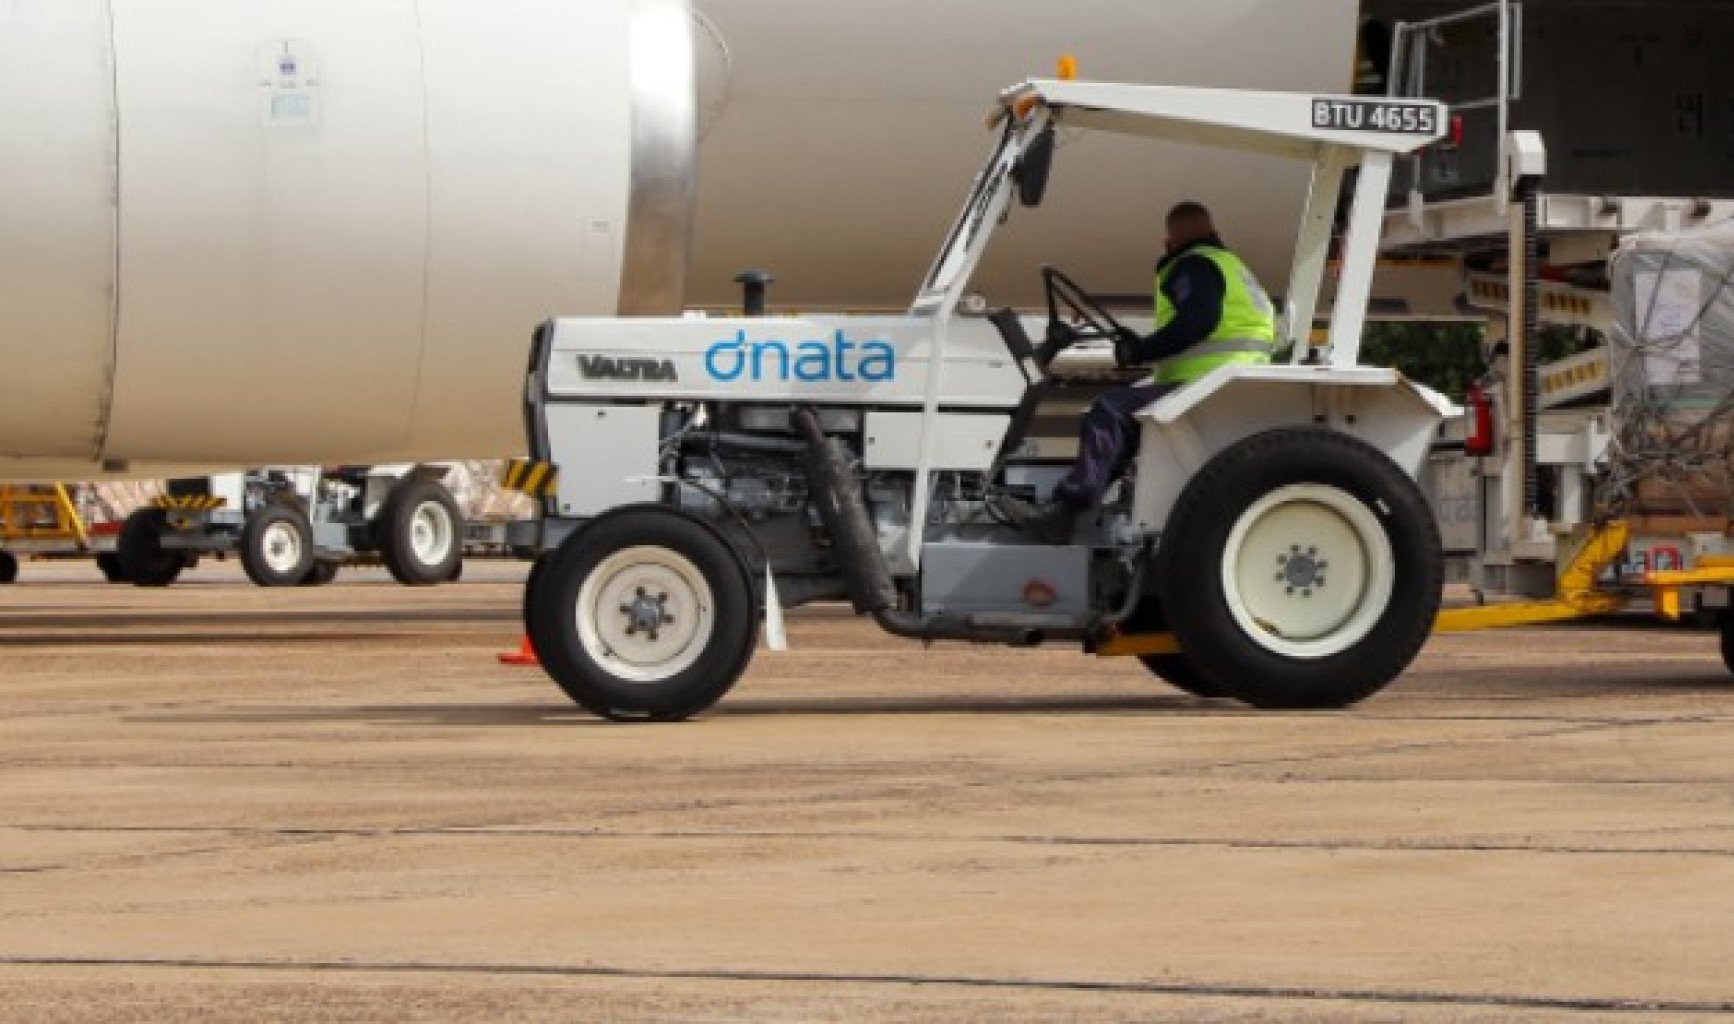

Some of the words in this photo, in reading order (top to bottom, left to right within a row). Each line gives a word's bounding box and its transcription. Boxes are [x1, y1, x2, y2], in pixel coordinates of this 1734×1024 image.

[1314, 101, 1363, 127] BTU
[1369, 105, 1432, 131] 4655
[576, 353, 678, 382] VALTRA
[705, 327, 896, 381] dnata
